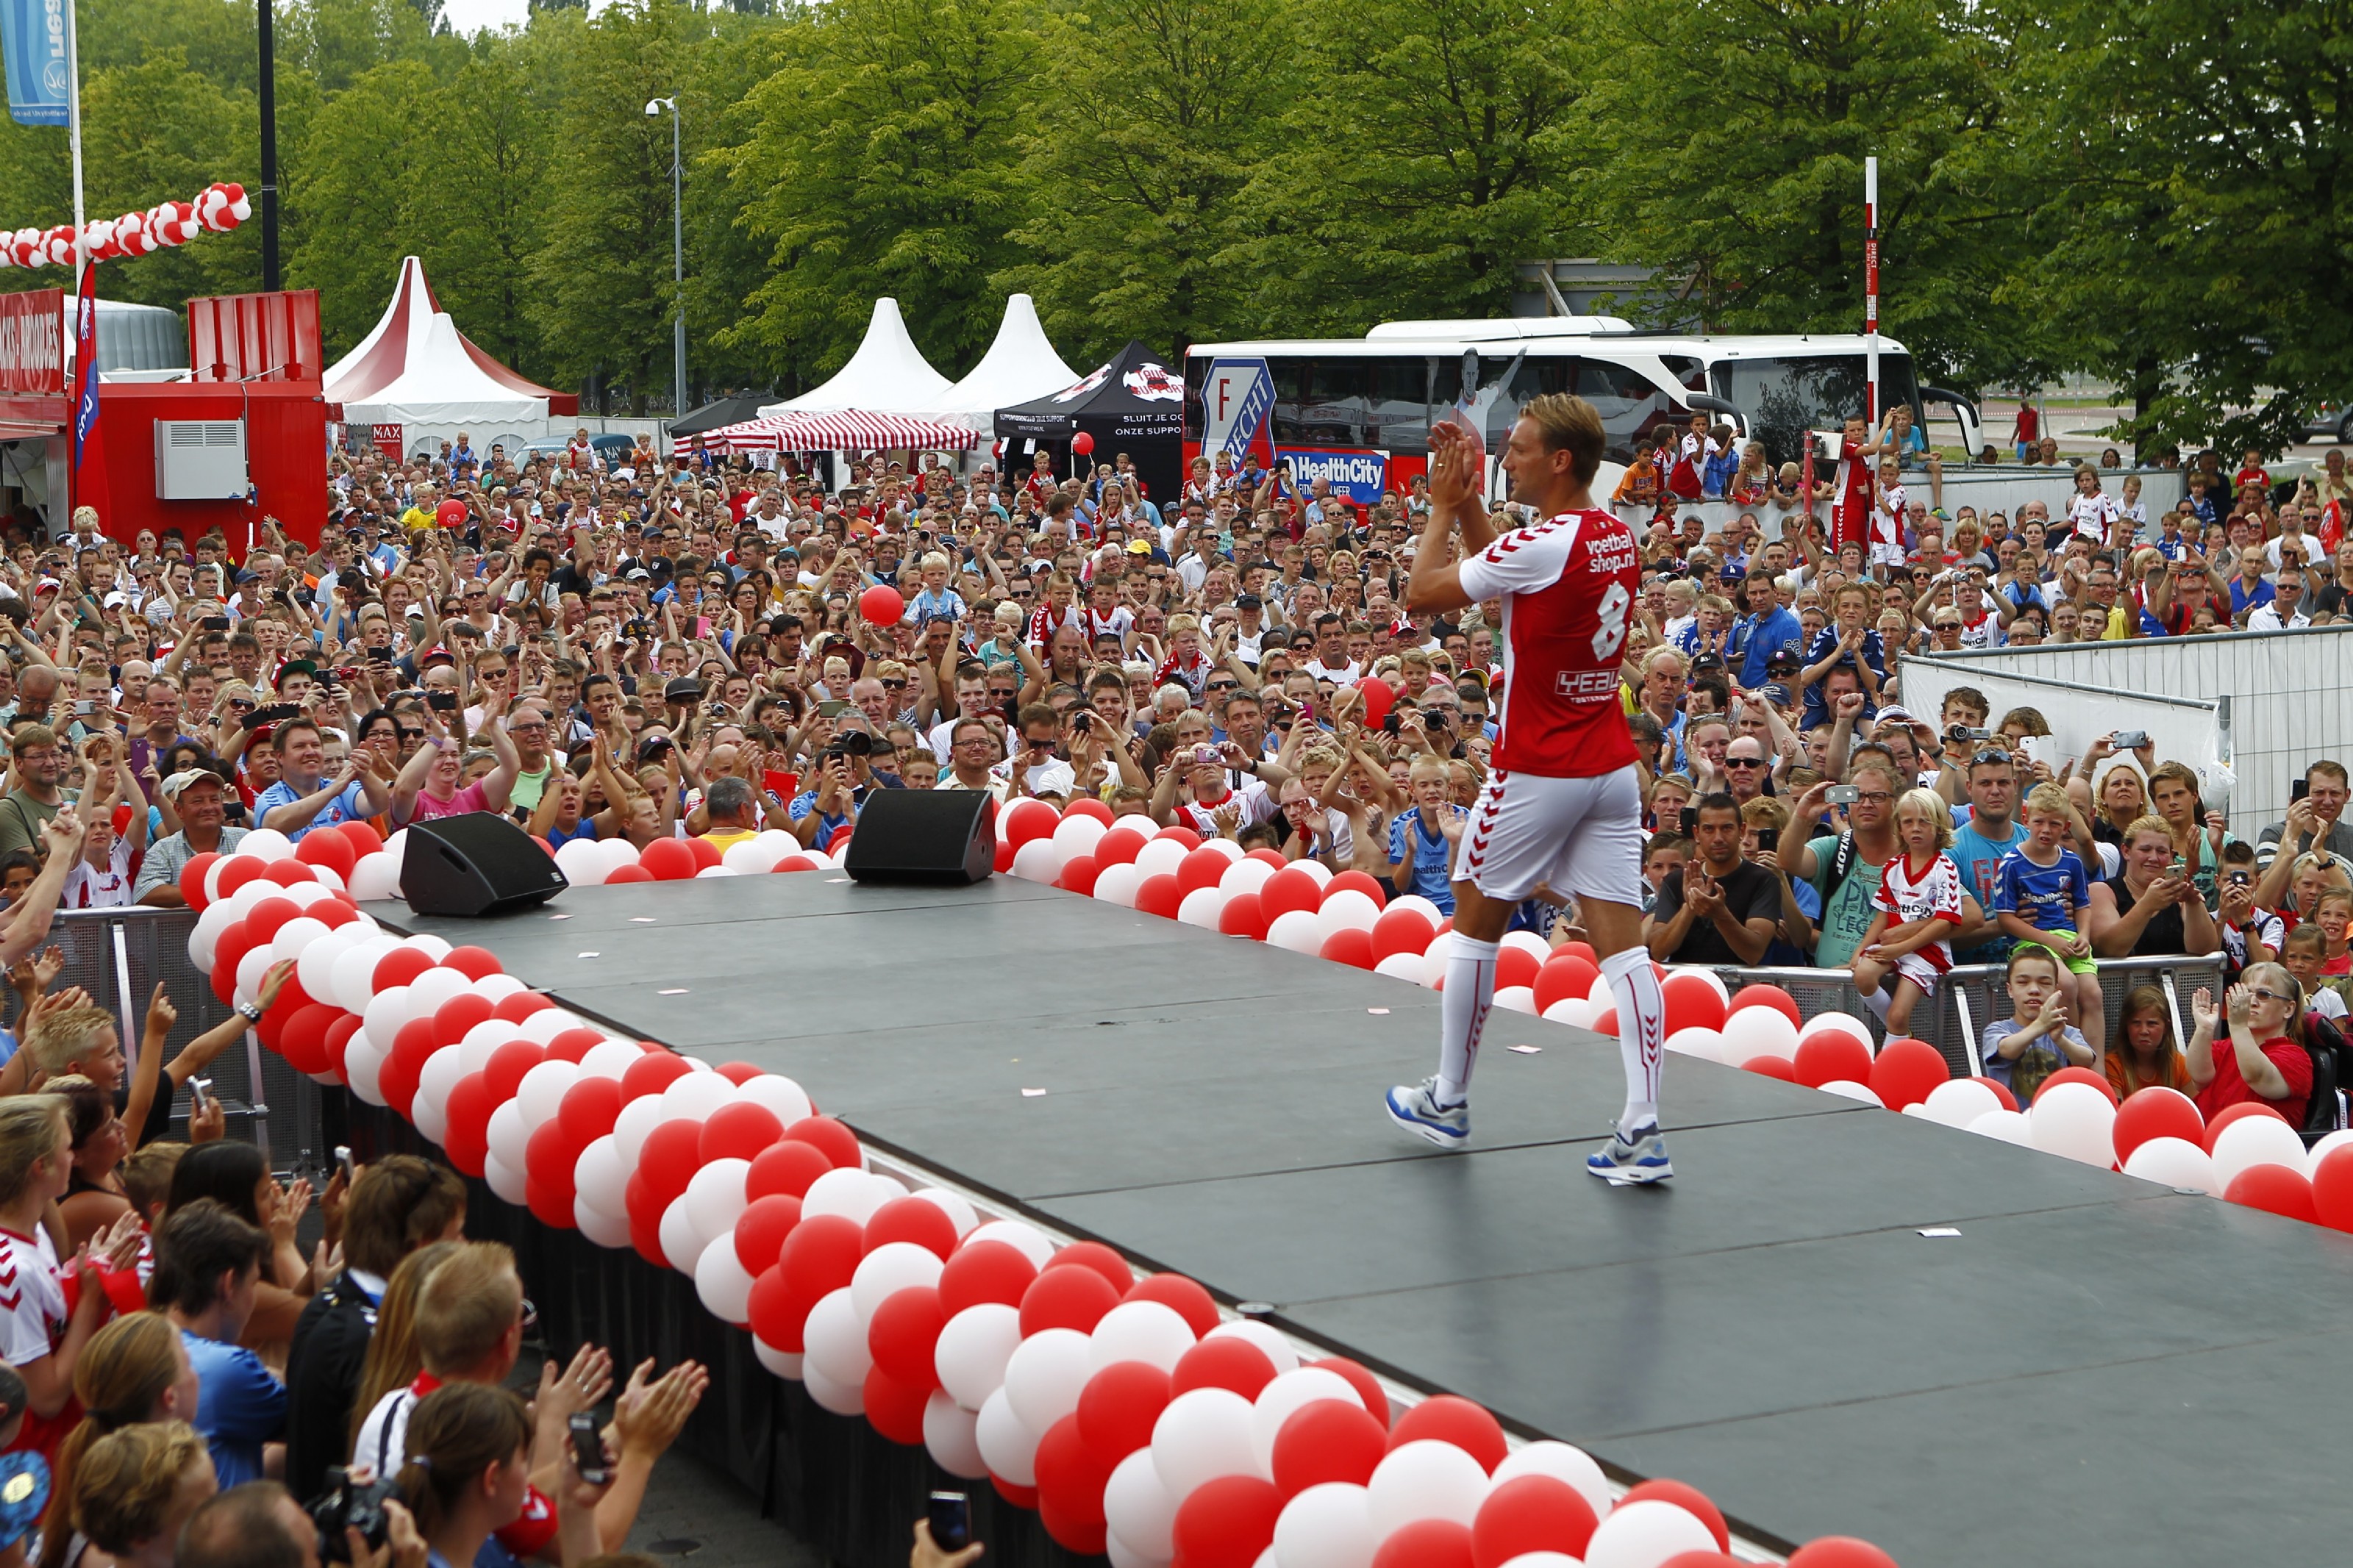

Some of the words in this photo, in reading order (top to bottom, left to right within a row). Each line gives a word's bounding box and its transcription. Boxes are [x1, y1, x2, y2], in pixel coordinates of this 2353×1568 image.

[0, 315, 15, 370] CKS
[1218, 379, 1230, 421] F
[1115, 428, 1144, 436] ONZE
[1124, 415, 1152, 423] SLUIT
[374, 426, 401, 439] MAX
[1298, 456, 1384, 490] HealthCity
[1586, 530, 1634, 556] voetbal
[1589, 548, 1635, 574] shop.nl
[1591, 581, 1630, 662] 8
